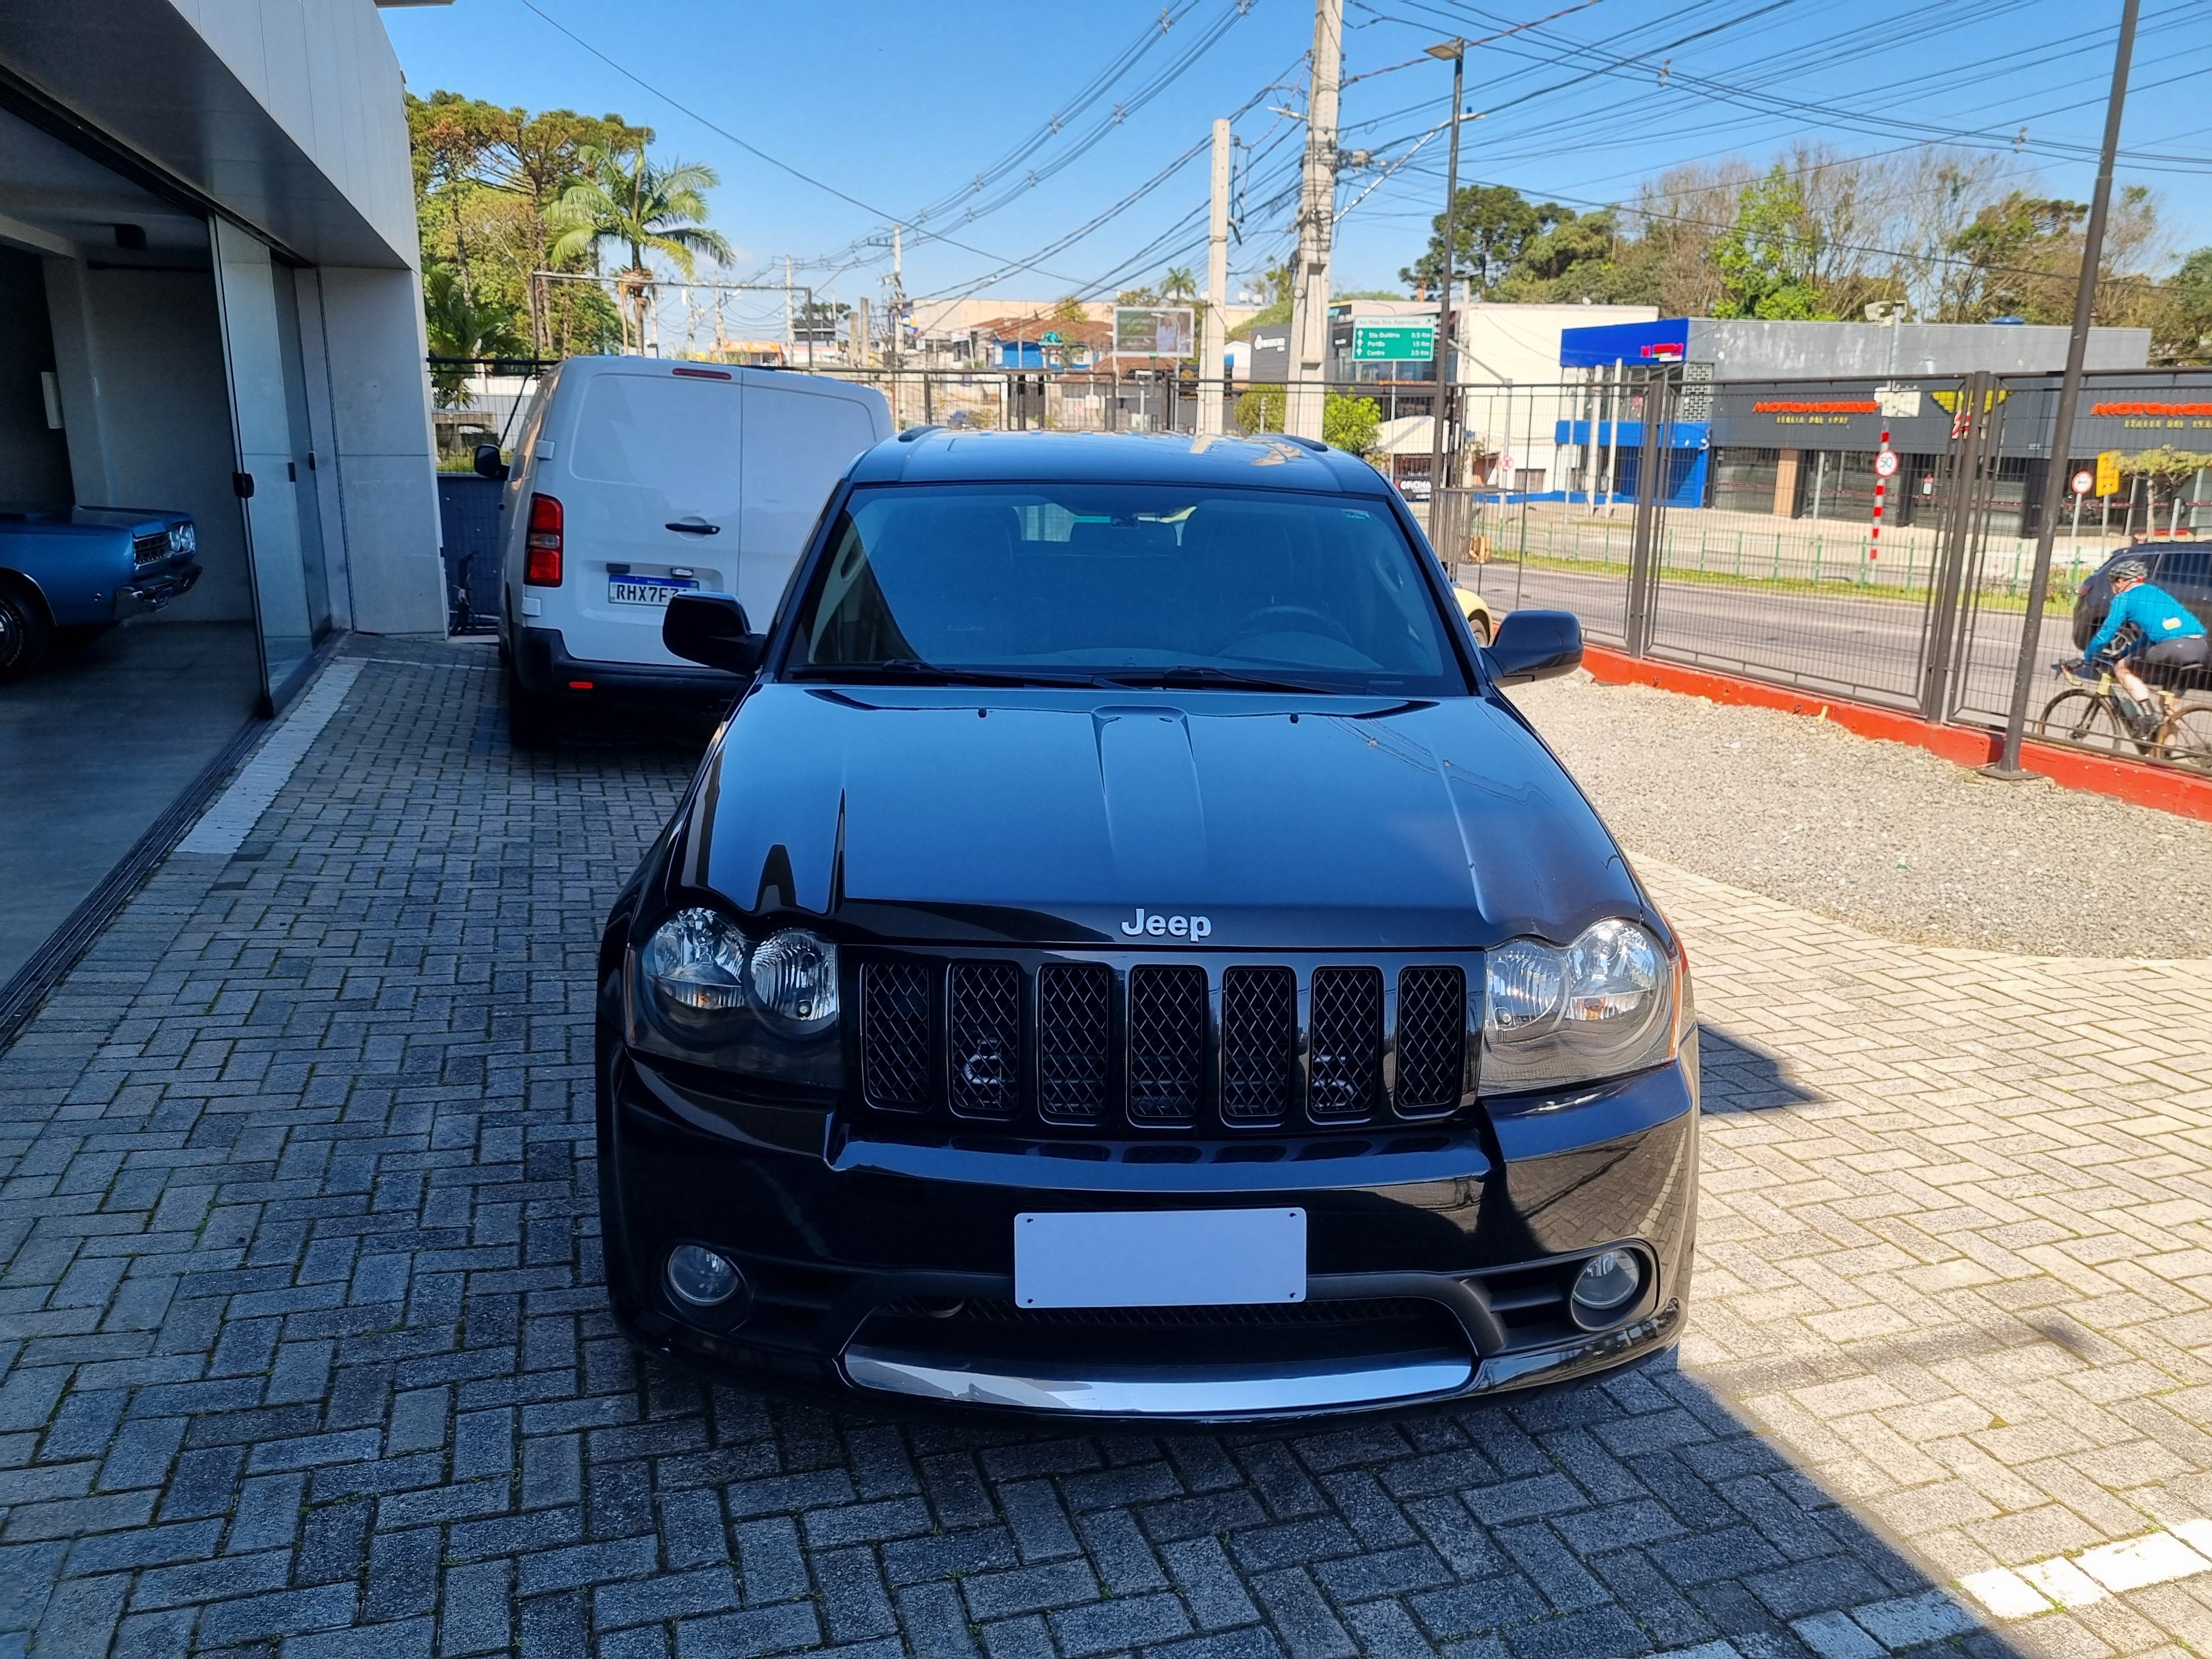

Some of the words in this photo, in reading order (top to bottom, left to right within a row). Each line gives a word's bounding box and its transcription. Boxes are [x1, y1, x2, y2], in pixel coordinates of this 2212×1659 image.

[1880, 457, 1893, 468] 50
[617, 584, 687, 603] RHX7F3
[1121, 907, 1212, 943] Jeep
